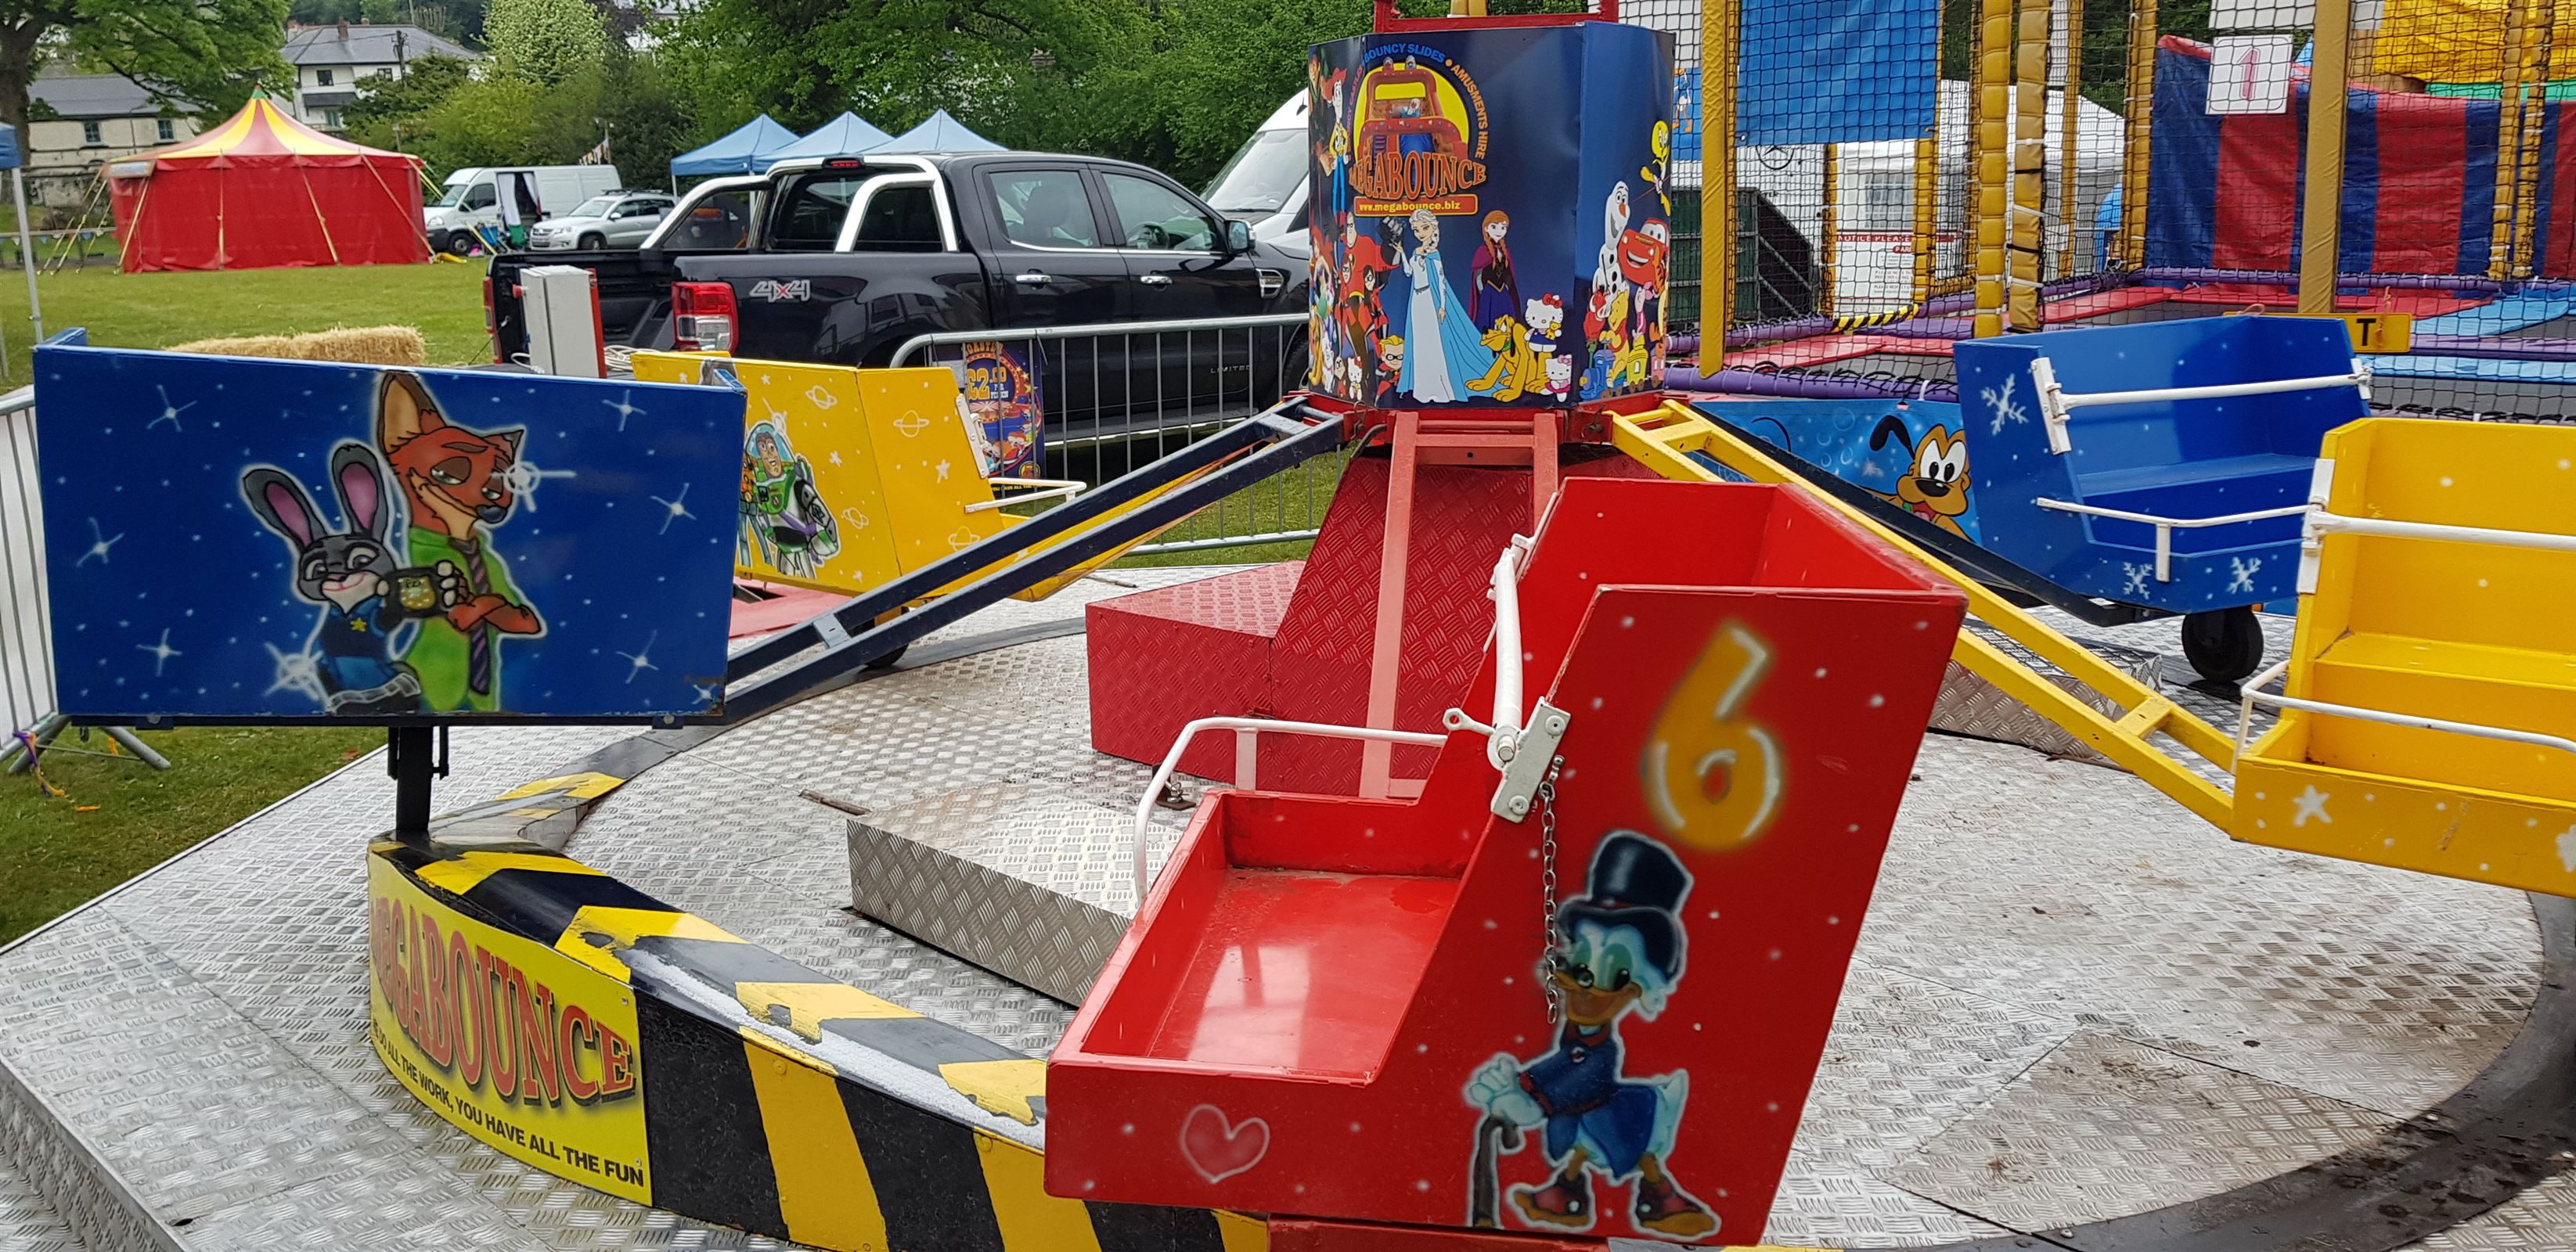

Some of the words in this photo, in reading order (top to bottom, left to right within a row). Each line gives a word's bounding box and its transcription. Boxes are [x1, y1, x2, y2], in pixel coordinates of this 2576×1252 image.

[1364, 43, 1407, 63] BOUNCY
[1407, 43, 1446, 63] SLIDES
[1475, 131, 1488, 160] HIRE
[1349, 152, 1486, 200] MEGABOUNCE
[1210, 365, 1252, 374] LIMITED
[1641, 617, 1784, 852] 6
[388, 1040, 401, 1067] ALL
[401, 1054, 419, 1084] THE
[419, 1070, 455, 1113] WORK,
[454, 1095, 483, 1125] YOU
[485, 1113, 525, 1146] HAVE
[529, 1133, 560, 1161] ALL
[562, 1145, 600, 1173] THE
[604, 1159, 643, 1187] FUN
